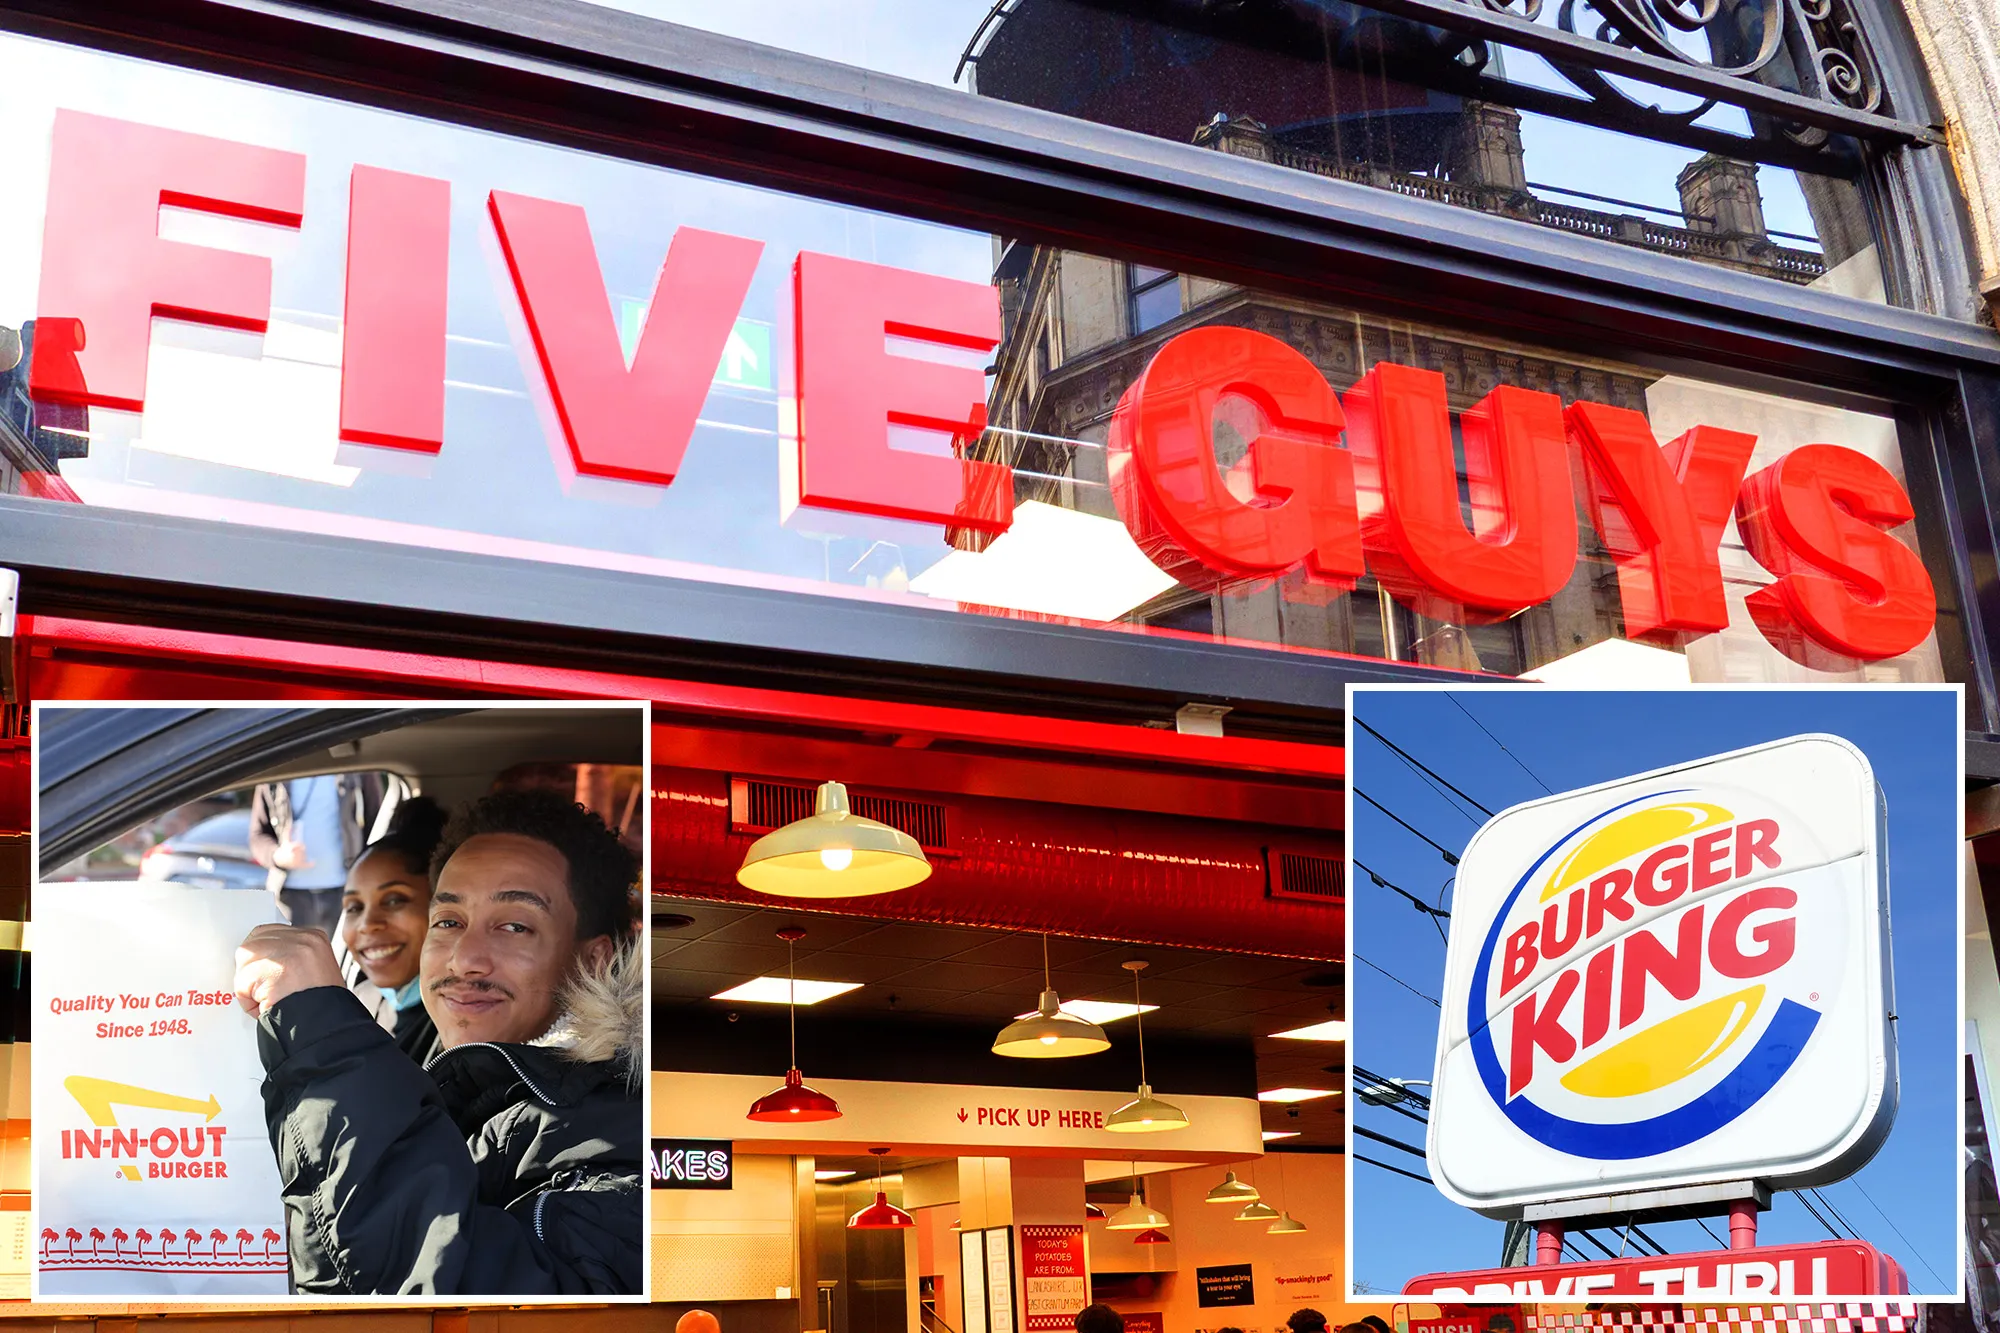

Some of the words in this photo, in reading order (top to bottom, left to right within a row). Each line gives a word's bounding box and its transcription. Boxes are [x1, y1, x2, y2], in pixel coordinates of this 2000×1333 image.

[30, 108, 1013, 536] FIVE
[1110, 326, 1936, 661] GUYS
[1500, 818, 1782, 999] BURGER
[50, 995, 115, 1015] Quality
[119, 994, 150, 1009] You
[155, 992, 183, 1008] Can
[187, 990, 233, 1006] Taste
[1509, 887, 1798, 1097] KING
[96, 1023, 144, 1038] Since
[149, 1019, 193, 1037] 1948.
[978, 1107, 1020, 1126] PICK
[1027, 1109, 1050, 1127] UP
[1059, 1110, 1103, 1129] HERE
[61, 1127, 227, 1159] IN-N-OUT
[149, 1162, 228, 1179] BURGER
[1037, 1240, 1068, 1249] TODAY'S
[1035, 1252, 1072, 1262] POTATOES
[1034, 1265, 1049, 1274] ARE
[1051, 1265, 1075, 1274] FROM:
